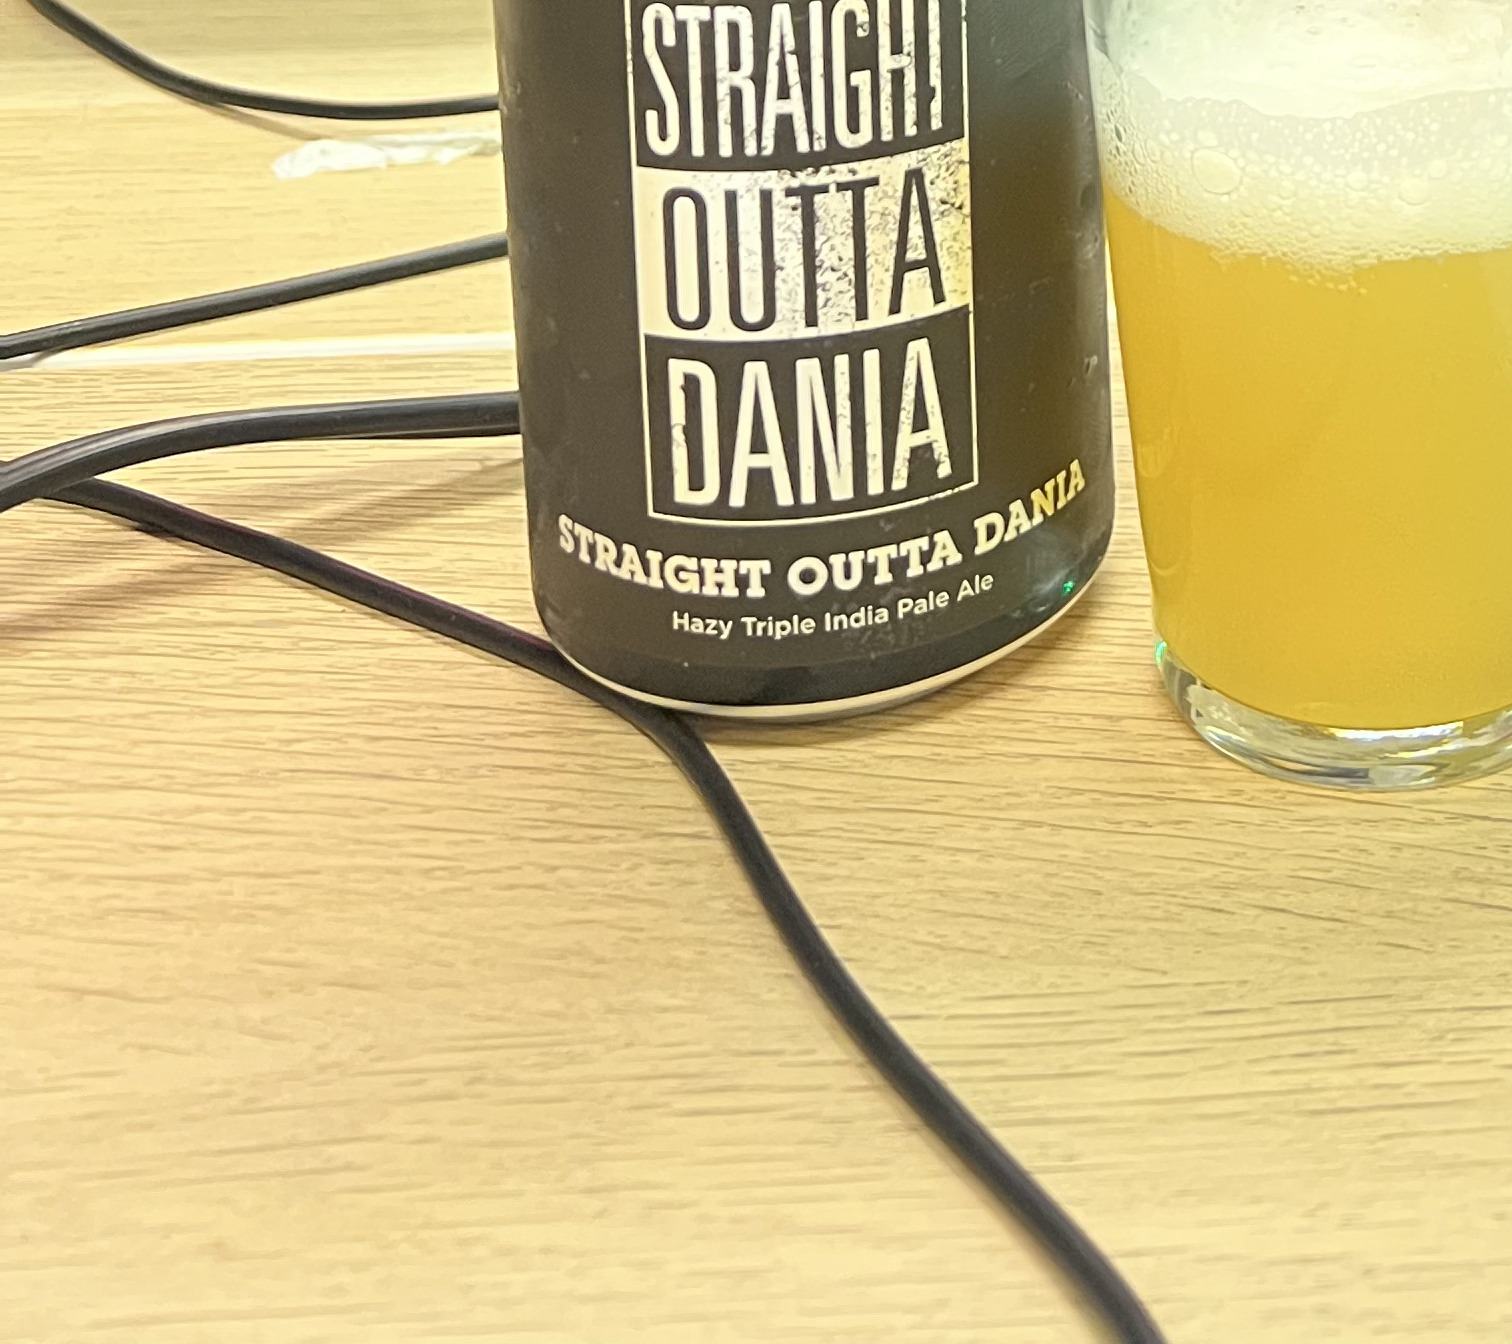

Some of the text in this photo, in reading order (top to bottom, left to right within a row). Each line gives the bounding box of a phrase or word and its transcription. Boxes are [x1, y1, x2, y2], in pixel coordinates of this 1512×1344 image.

[661, 167, 947, 331] OUTTA
[667, 337, 952, 507] DANIA
[558, 459, 1087, 598] STRAIGHT OUTTA DANIA
[672, 572, 995, 639] Hazy Triple India Pale Ale
